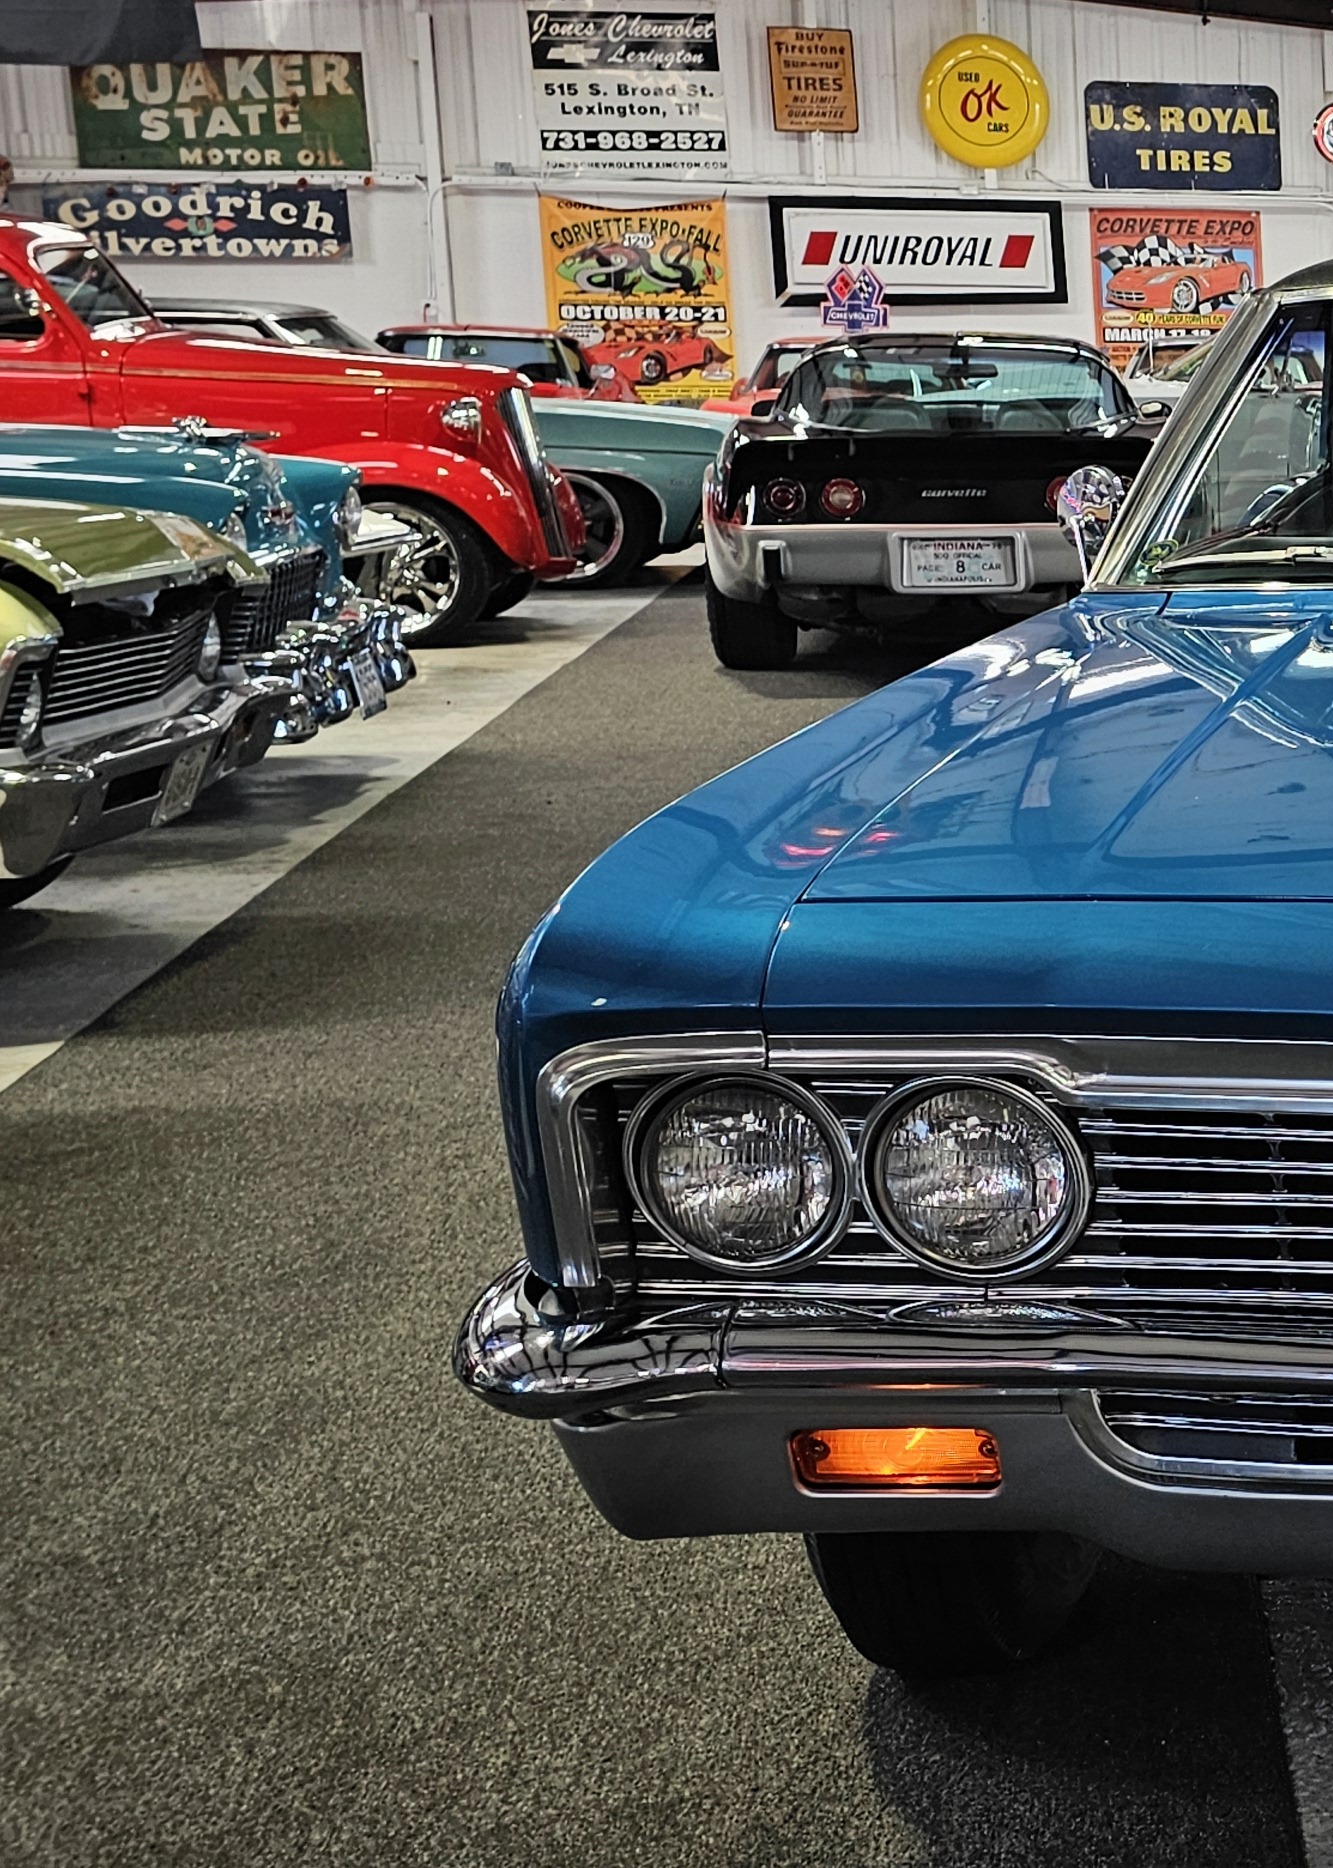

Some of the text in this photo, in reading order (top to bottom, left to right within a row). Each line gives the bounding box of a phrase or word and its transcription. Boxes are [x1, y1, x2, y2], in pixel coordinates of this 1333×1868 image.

[531, 13, 714, 43] Jones Chevrolet
[795, 32, 824, 41] BUY
[608, 44, 705, 68] Lexington
[775, 41, 846, 56] Firestone
[81, 53, 354, 110] QUAKER
[783, 76, 843, 92] TIRES
[957, 71, 980, 83] USED
[544, 83, 714, 98] 515 S. Broad St.
[792, 95, 838, 104] NO LIMIT
[960, 78, 1010, 123] OK
[560, 102, 700, 119] Lexington, TN
[1089, 104, 1276, 135] U.S. ROYAL
[139, 103, 302, 141] STATE
[987, 122, 1009, 134] CARS
[542, 131, 724, 150] 731-968-2527
[179, 147, 345, 166] MOTOR OIL
[1136, 149, 1233, 172] TIRES
[58, 182, 335, 236] Goodrich
[550, 217, 722, 253] CORVETTE EXPO FALL
[1096, 217, 1255, 236] CORVETTE EXPO
[92, 231, 338, 257] ilvertowns
[838, 234, 993, 267] UNIROYAL
[560, 305, 726, 322] OCTOBER 20-21
[1104, 328, 1166, 342] MARCH
[921, 488, 987, 498] corvette
[933, 542, 983, 551] INDIANA
[956, 560, 965, 573] 8
[981, 563, 1001, 571] CAR
